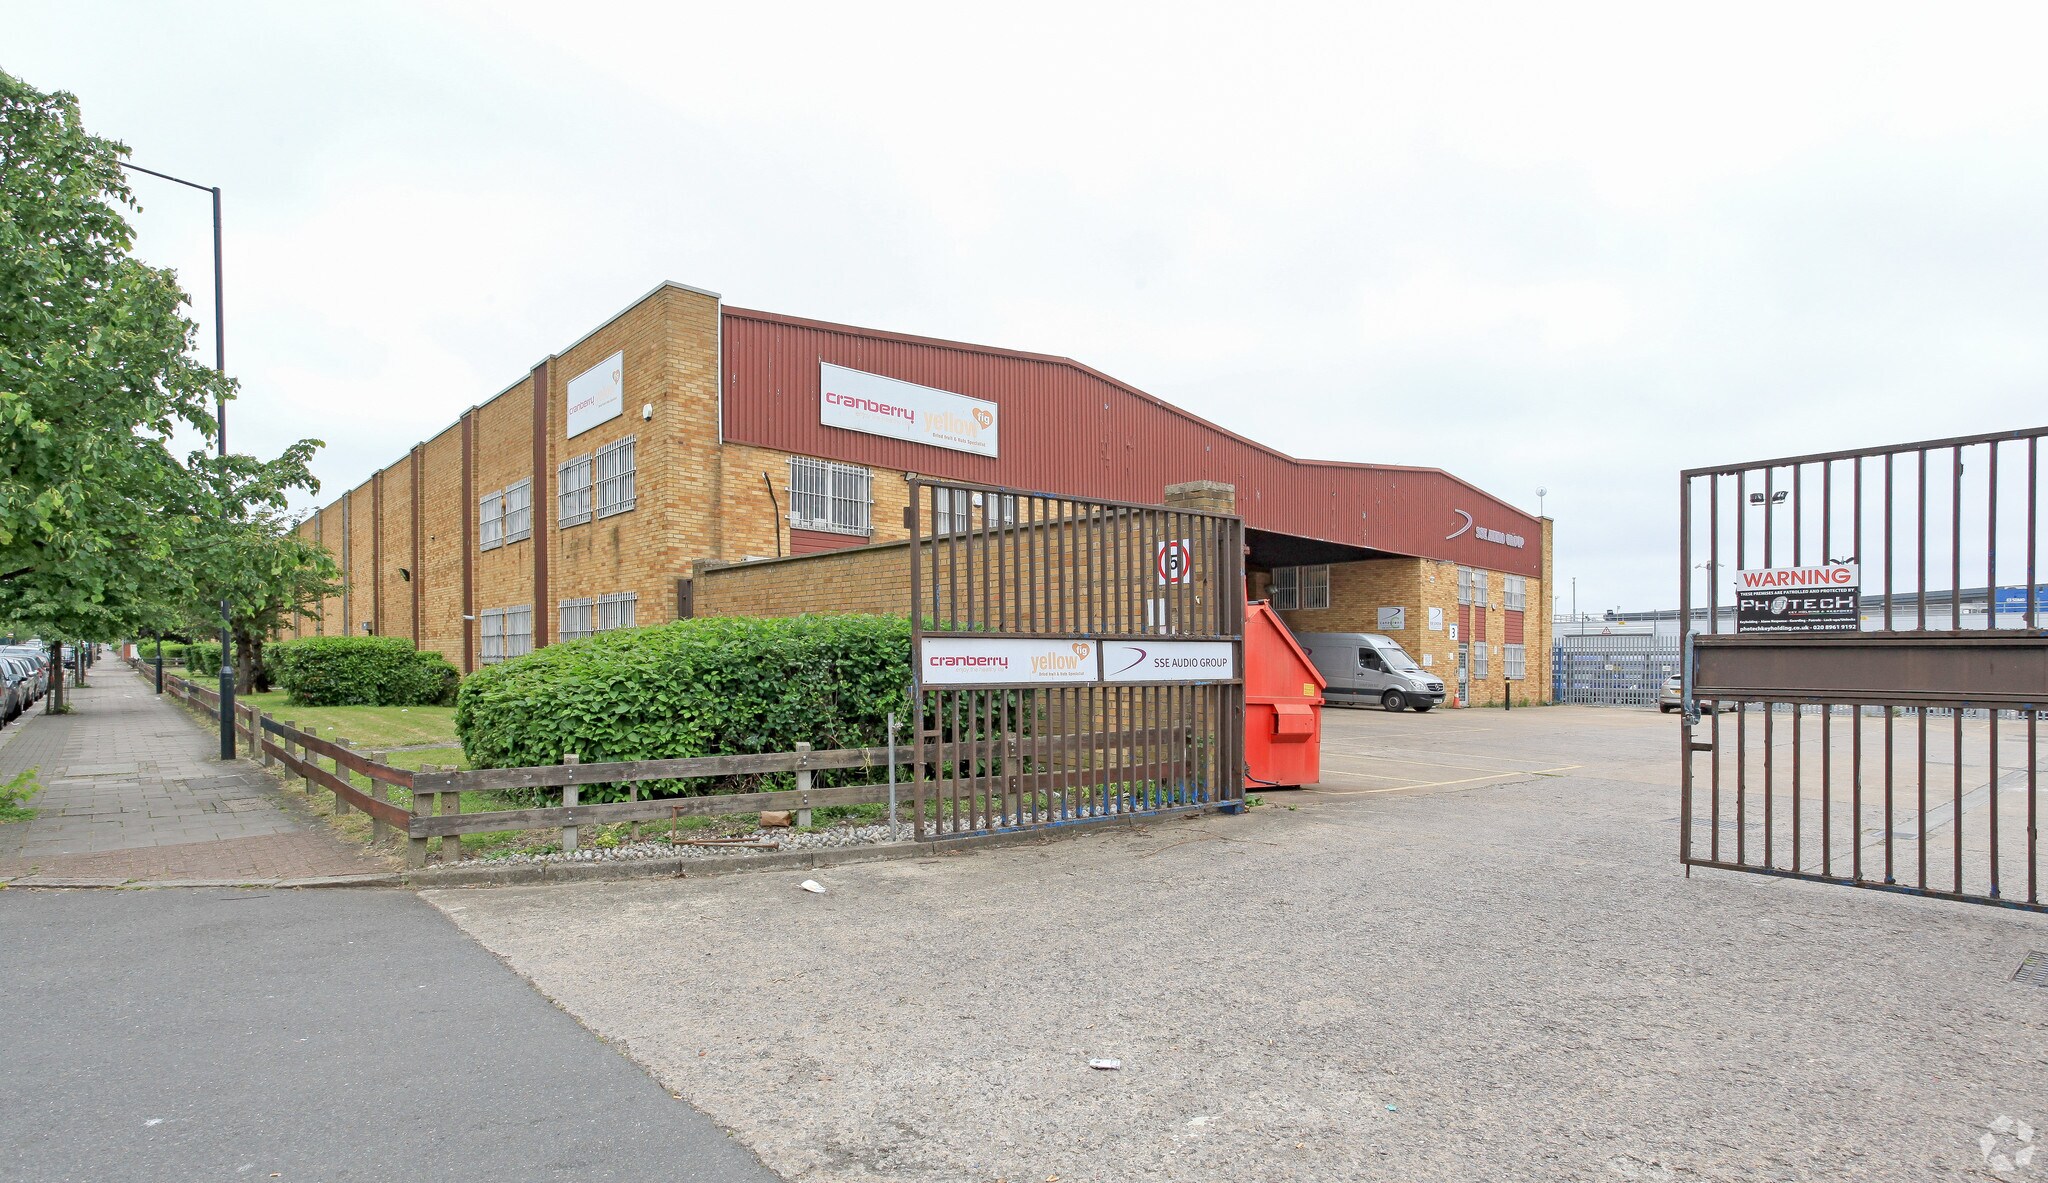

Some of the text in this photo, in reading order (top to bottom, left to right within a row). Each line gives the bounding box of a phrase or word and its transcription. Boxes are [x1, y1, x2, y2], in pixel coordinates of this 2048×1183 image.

[826, 392, 915, 424] cranberry
[924, 411, 979, 438] yellow
[978, 412, 990, 425] fig
[1743, 568, 1851, 588] WARNING
[1451, 627, 1456, 638] 3
[1076, 645, 1088, 656] fig
[930, 655, 1008, 669] cranberry
[1031, 651, 1078, 673] yellow
[1154, 658, 1228, 668] SSE AUDIO GROUP
